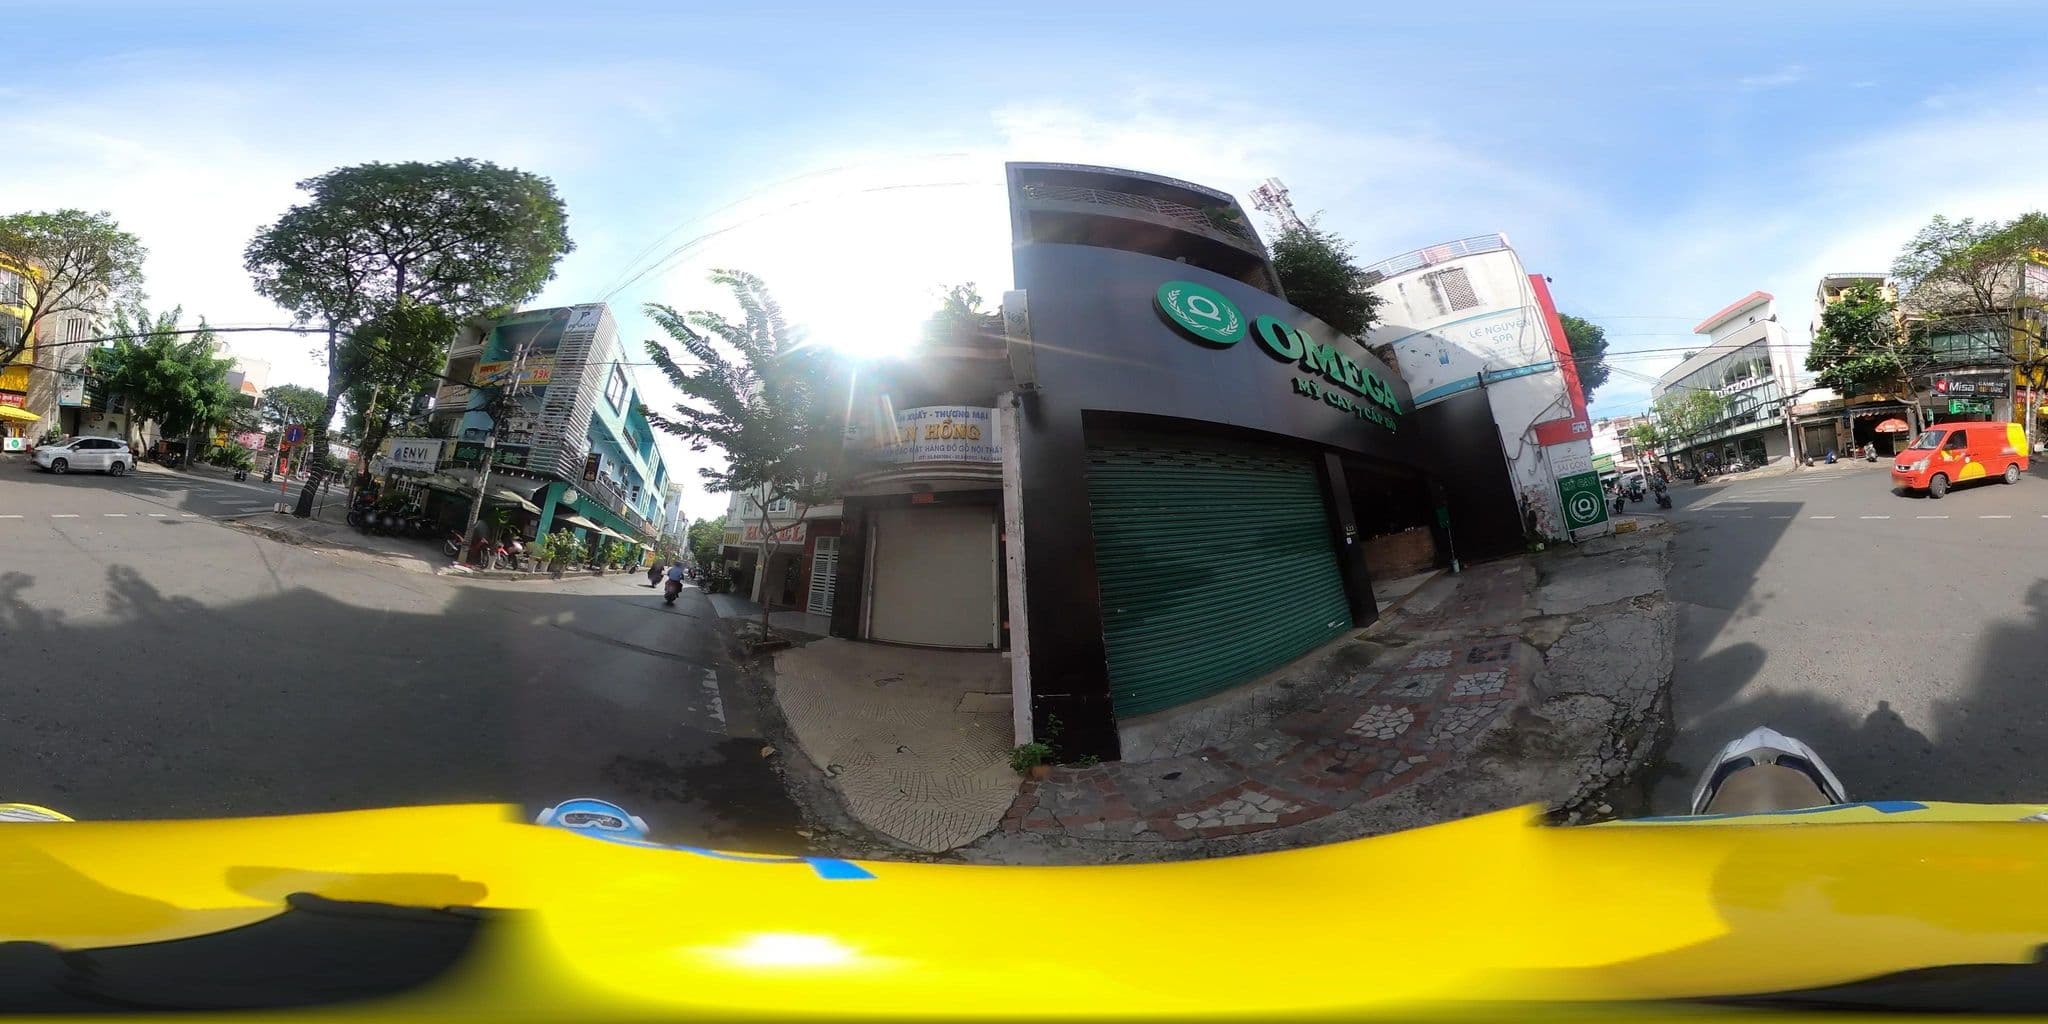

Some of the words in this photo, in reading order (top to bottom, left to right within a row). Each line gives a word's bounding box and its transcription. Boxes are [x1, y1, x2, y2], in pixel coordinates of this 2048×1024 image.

[1493, 333, 1514, 344] SPA
[1254, 314, 1402, 416] OMEGA
[1949, 382, 1975, 391] Misa
[1326, 390, 1353, 411] CAY
[403, 446, 428, 460] ENVI
